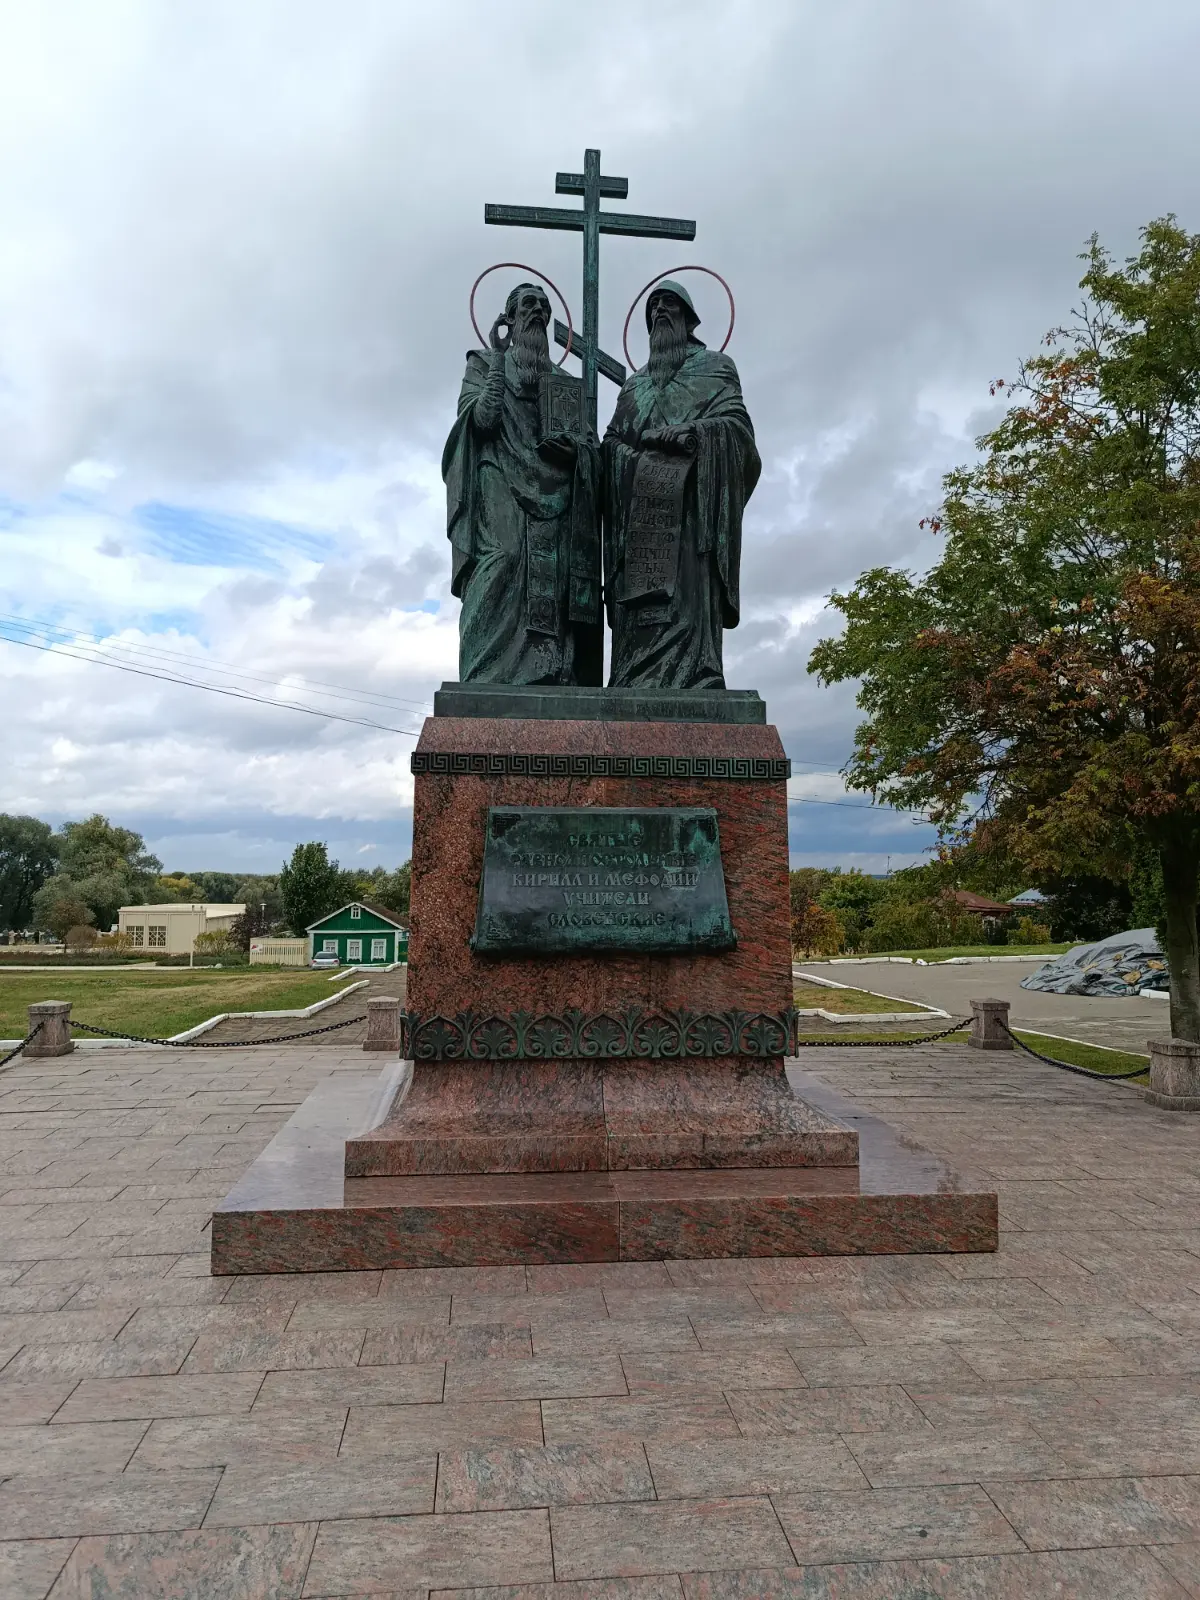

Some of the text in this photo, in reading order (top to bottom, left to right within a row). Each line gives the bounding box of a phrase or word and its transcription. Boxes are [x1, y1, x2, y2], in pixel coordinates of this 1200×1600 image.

[511, 873, 584, 888] КИРИЛЛ
[587, 873, 601, 887] И
[563, 890, 651, 907] УЧИТЕЛИ
